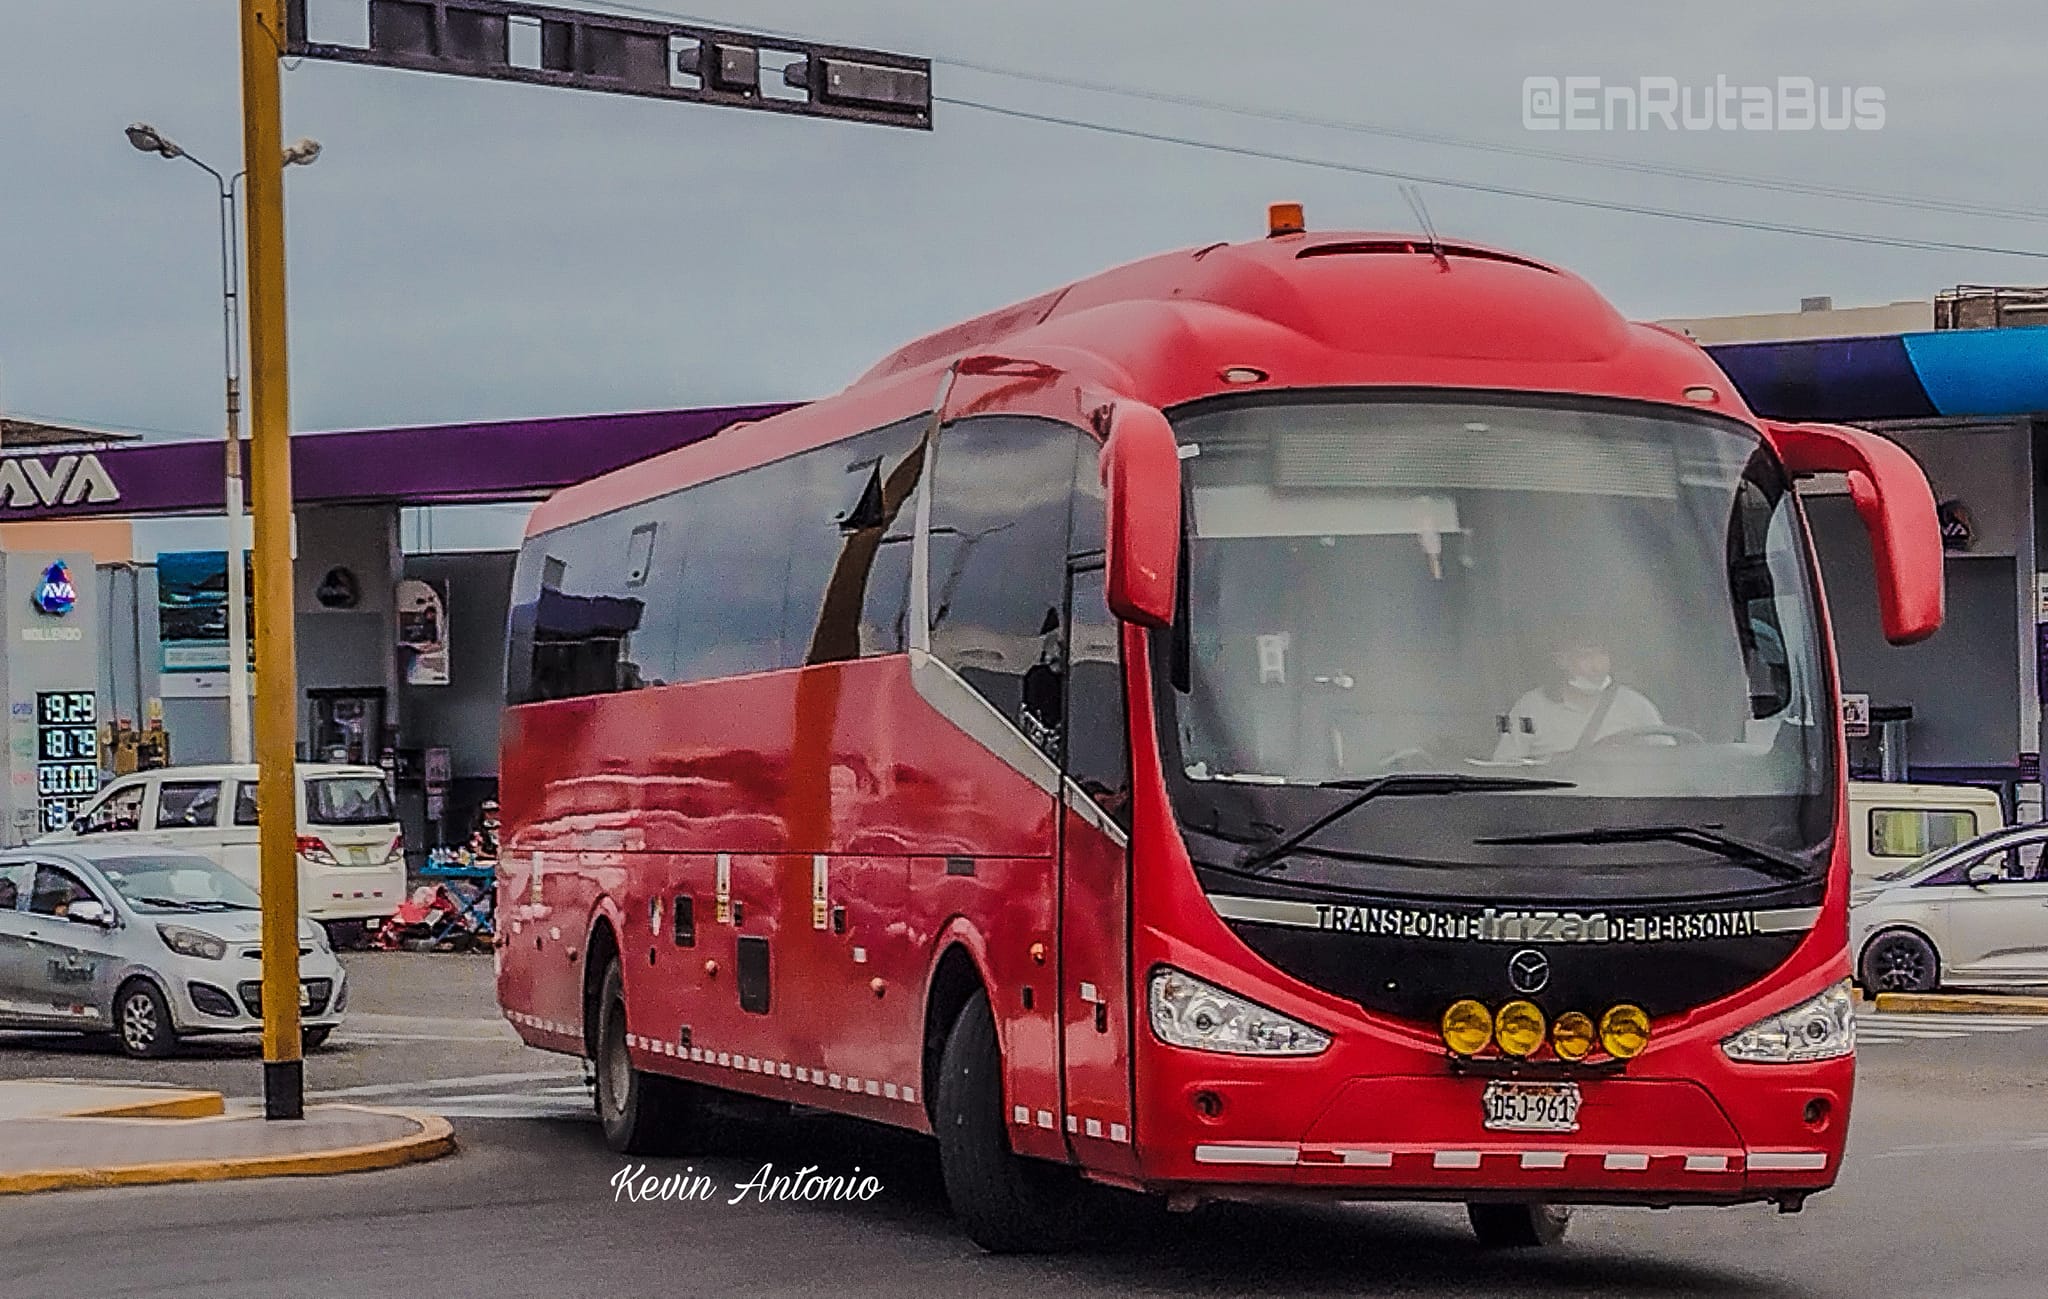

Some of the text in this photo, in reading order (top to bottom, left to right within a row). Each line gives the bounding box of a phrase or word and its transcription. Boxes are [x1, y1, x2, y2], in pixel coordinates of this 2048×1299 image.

[0, 454, 120, 507] AVA
[39, 765, 98, 793] 00.00
[1316, 905, 1482, 939] TRANSPORTE
[1643, 910, 1763, 941] PERSONAL
